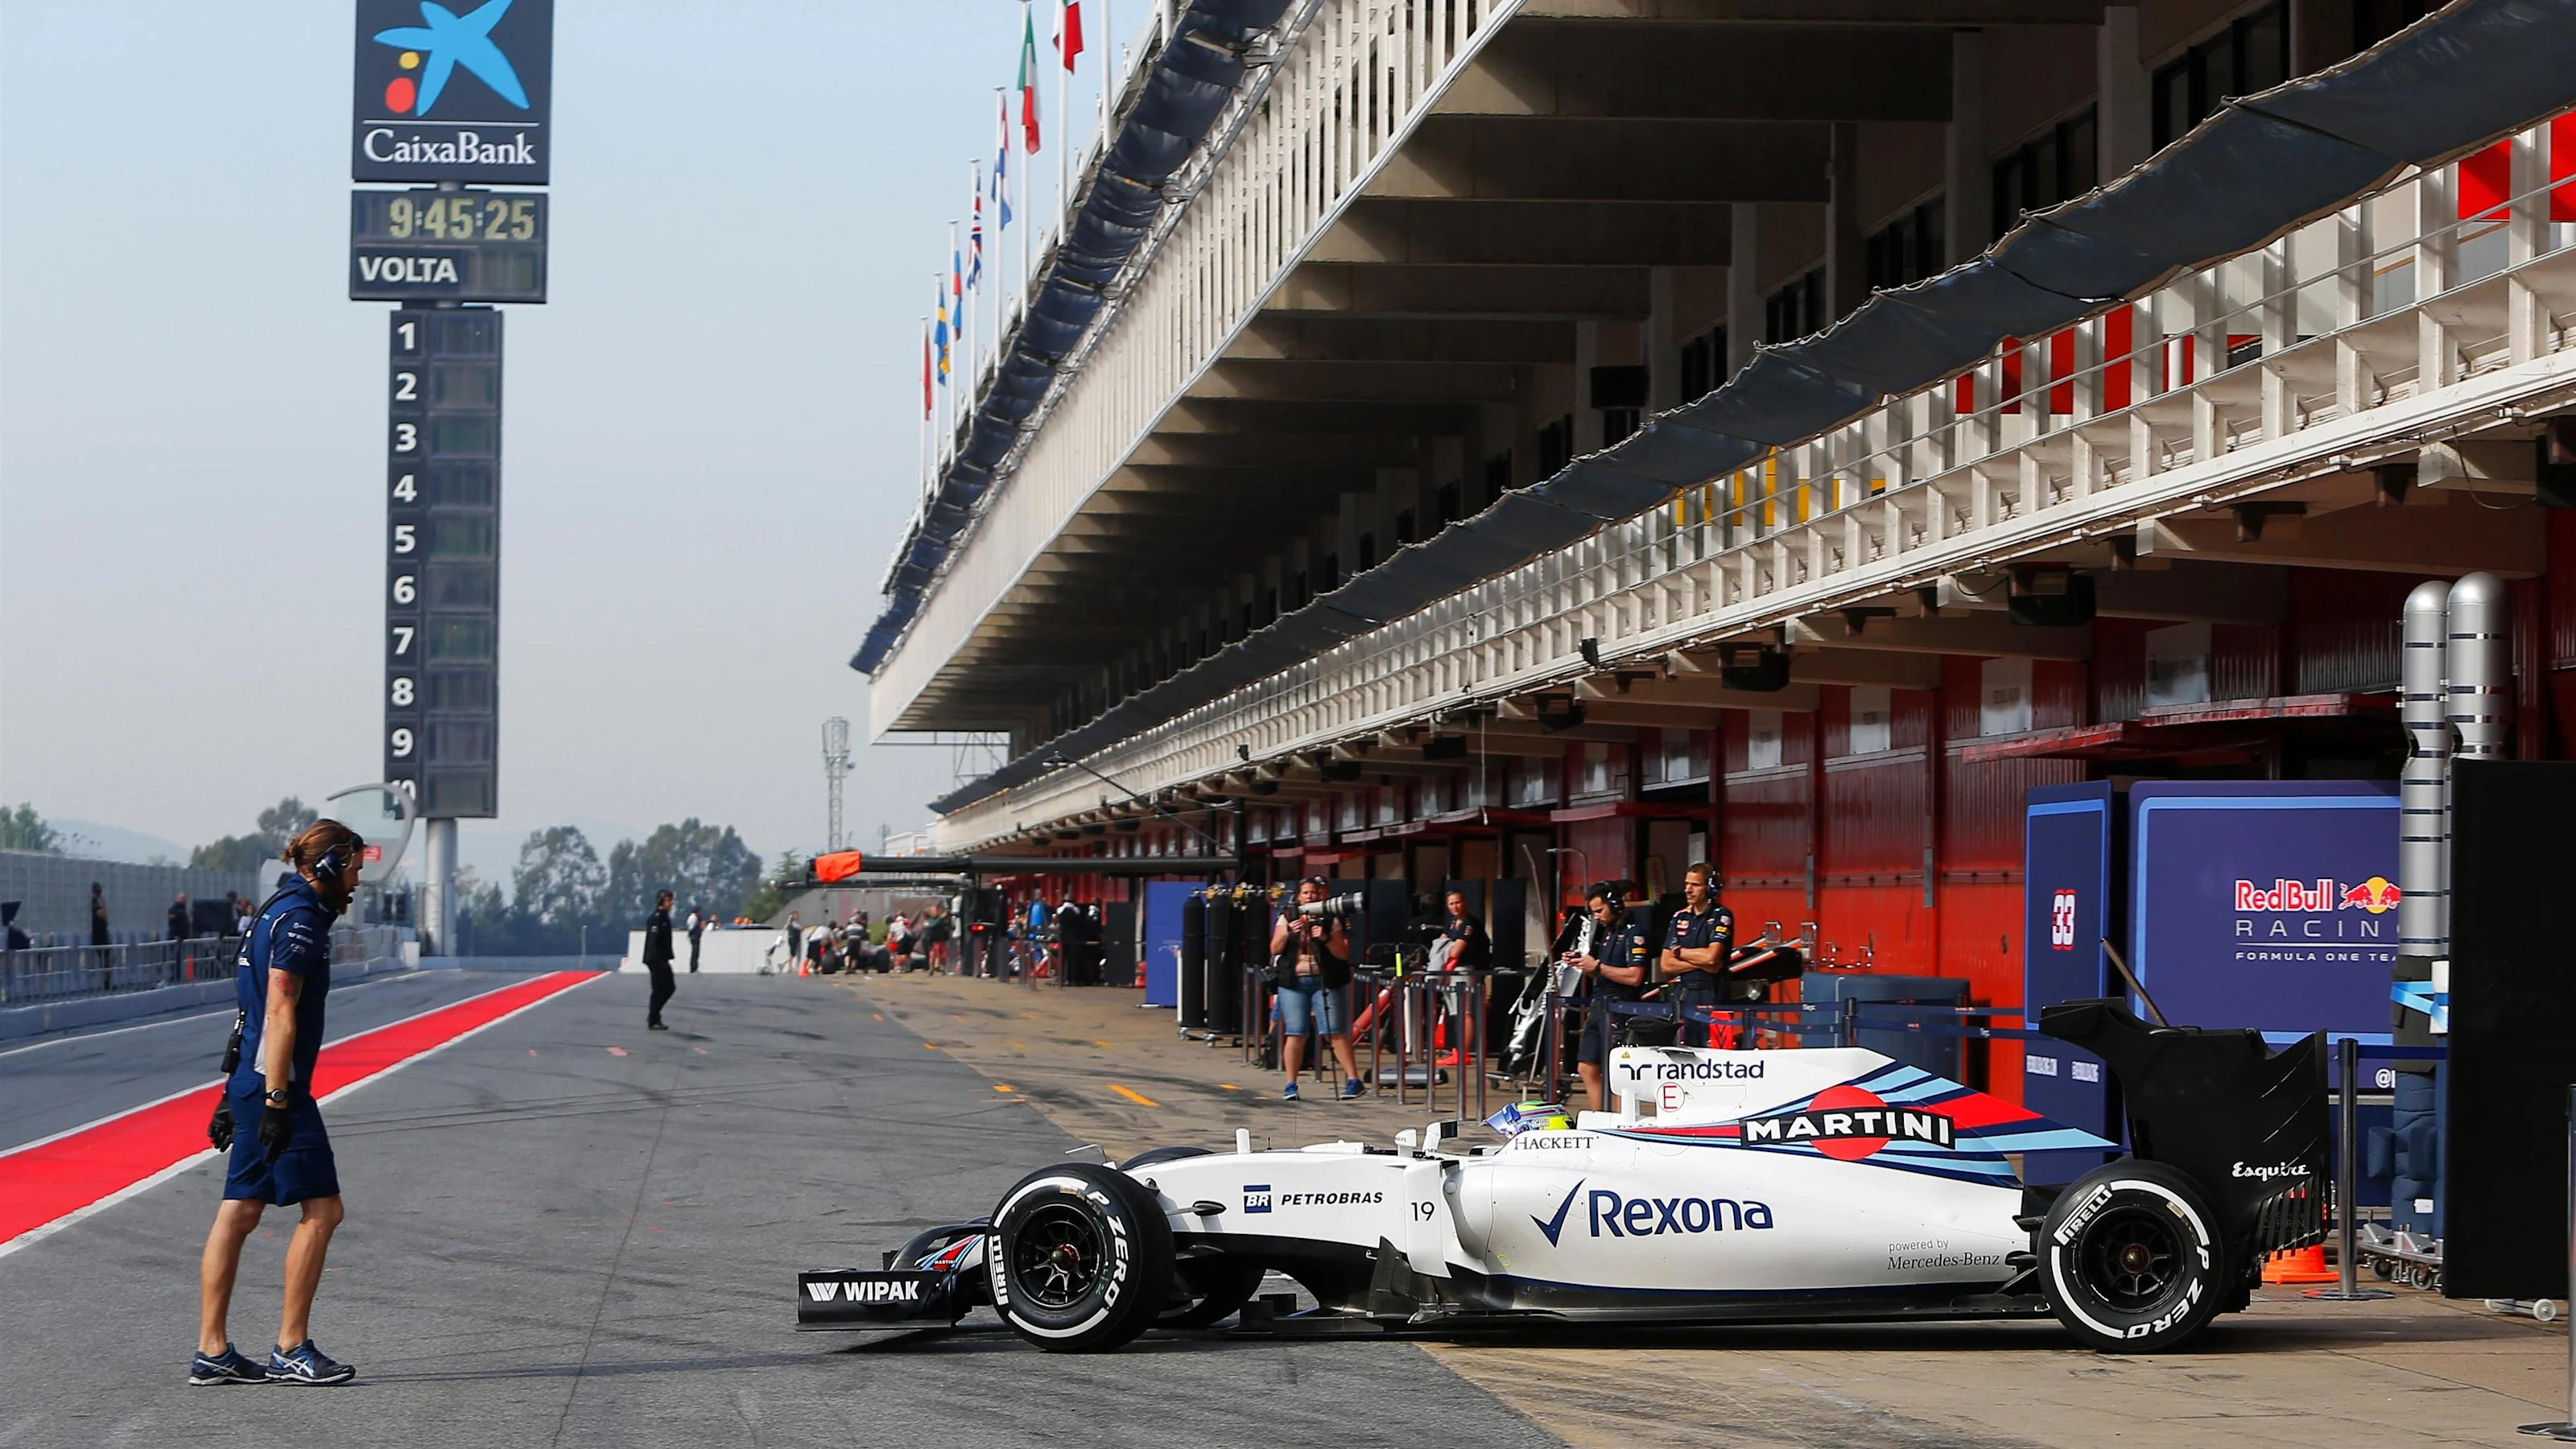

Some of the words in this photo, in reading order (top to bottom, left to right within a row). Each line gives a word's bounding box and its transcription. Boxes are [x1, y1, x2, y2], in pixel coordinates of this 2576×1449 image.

[363, 127, 537, 165] CaixaBank
[389, 198, 535, 240] 9:45:25
[358, 256, 458, 283] VOLTA
[397, 323, 416, 349] 1
[396, 373, 417, 401] 2
[395, 423, 417, 452] 3
[393, 474, 417, 502] 4
[394, 525, 415, 553] 5
[394, 575, 415, 604] 6
[393, 626, 415, 655] 7
[391, 677, 414, 706] 8
[390, 728, 413, 756] 9
[2051, 889, 2076, 950] 33
[2235, 919, 2400, 937] RACIN
[2235, 952, 2316, 961] FORMULA
[2326, 952, 2359, 961] ONE
[1657, 1059, 1765, 1080] randstad
[1663, 1085, 1678, 1109] E
[1747, 1112, 1949, 1144] MARTINI
[1513, 1136, 1594, 1150] HACKETT
[2231, 1162, 2310, 1182] Esquire
[1245, 1195, 1269, 1208] BR
[1281, 1191, 1384, 1206] PETROBRAS
[1411, 1201, 1435, 1221] 19
[1588, 1190, 1773, 1238] Rexona
[2054, 1183, 2112, 1246] PIRELLI
[1088, 1191, 1110, 1206] P
[1104, 1215, 1129, 1308] ZERO
[1889, 1240, 1932, 1253] powered
[1936, 1238, 1949, 1250] by
[2197, 1245, 2209, 1269] P
[989, 1234, 1009, 1306] PIRELLI
[1887, 1253, 2000, 1270] Mercedes-Benz
[844, 1281, 919, 1302] WIPAK
[2126, 1277, 2203, 1340] ZERO
